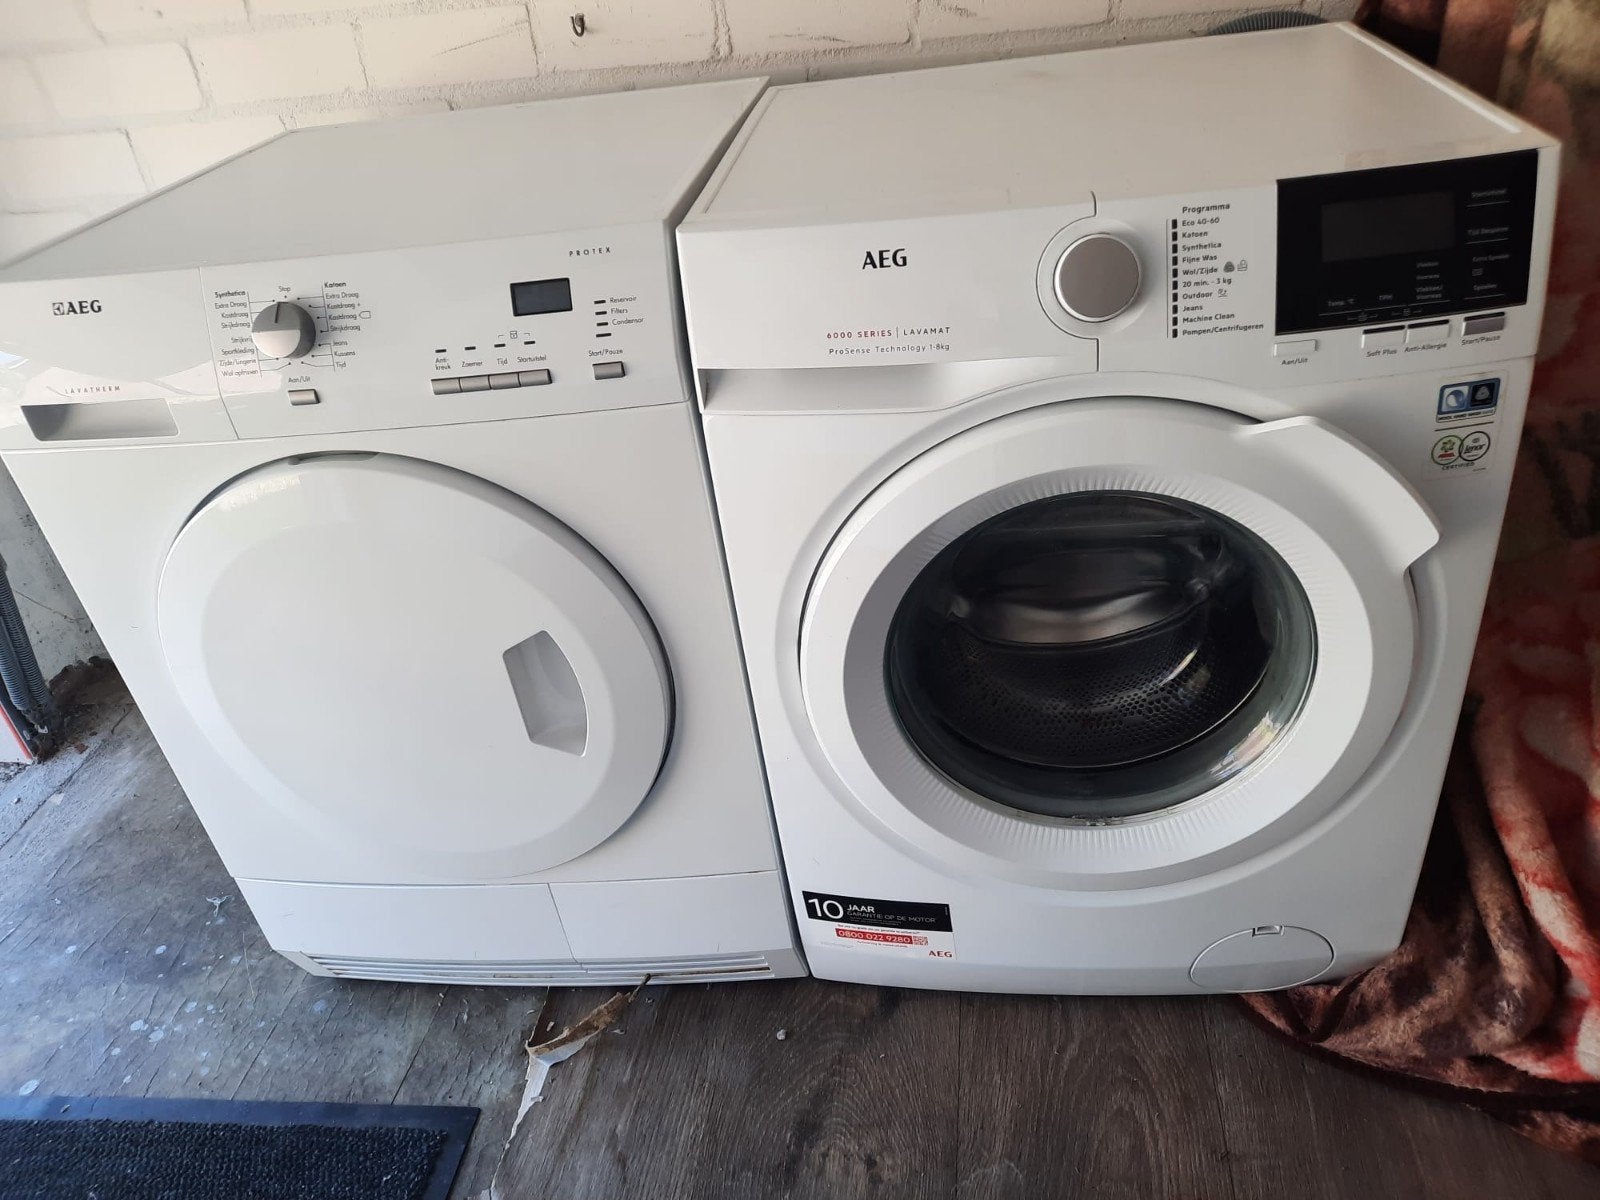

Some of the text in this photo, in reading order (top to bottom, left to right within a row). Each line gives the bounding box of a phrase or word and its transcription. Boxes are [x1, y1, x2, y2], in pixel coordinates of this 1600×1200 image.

[1182, 203, 1231, 214] Programma
[1197, 217, 1220, 225] 40-60
[569, 246, 611, 257] PROTEX
[1182, 242, 1222, 252] Synthetica
[862, 248, 908, 270] AEG
[1182, 266, 1218, 276] Wol/Zijde
[1182, 280, 1192, 288] 20
[1193, 279, 1210, 287] min.
[1222, 277, 1232, 285] kg
[278, 285, 291, 293] Stop
[214, 290, 246, 299] Synthetica
[341, 291, 359, 299] Droog
[1182, 291, 1213, 300] Outdoor
[609, 296, 637, 304] Reservoir
[66, 300, 102, 315] AEG
[327, 302, 355, 310] Kastdroog
[221, 311, 249, 319] Kastdroog
[610, 307, 628, 315] Filters
[328, 313, 357, 321] Kastdroog
[611, 317, 644, 326] Condensor
[1182, 315, 1212, 324] Machine
[857, 329, 892, 338] SERIES
[903, 326, 950, 336] LAVAMAT
[1182, 323, 1264, 336] Pompen/Centrifugeren
[588, 348, 623, 357] Start/Pauze
[829, 343, 950, 355] ProSense Technology 1-8kg
[335, 360, 347, 369] Tijd
[461, 360, 483, 368] Zoemer
[496, 357, 508, 366] Tijd
[1281, 357, 1308, 366] Aan/Uit
[288, 375, 311, 383] Aan/Uit
[64, 385, 121, 395] LAVATHERM
[808, 898, 844, 920] 10
[847, 904, 876, 914] JAAR
[847, 911, 883, 920] GARANTIE
[908, 916, 937, 924] MOTOR
[837, 930, 911, 943] 0800 022 9280
[928, 950, 953, 959] AEG
